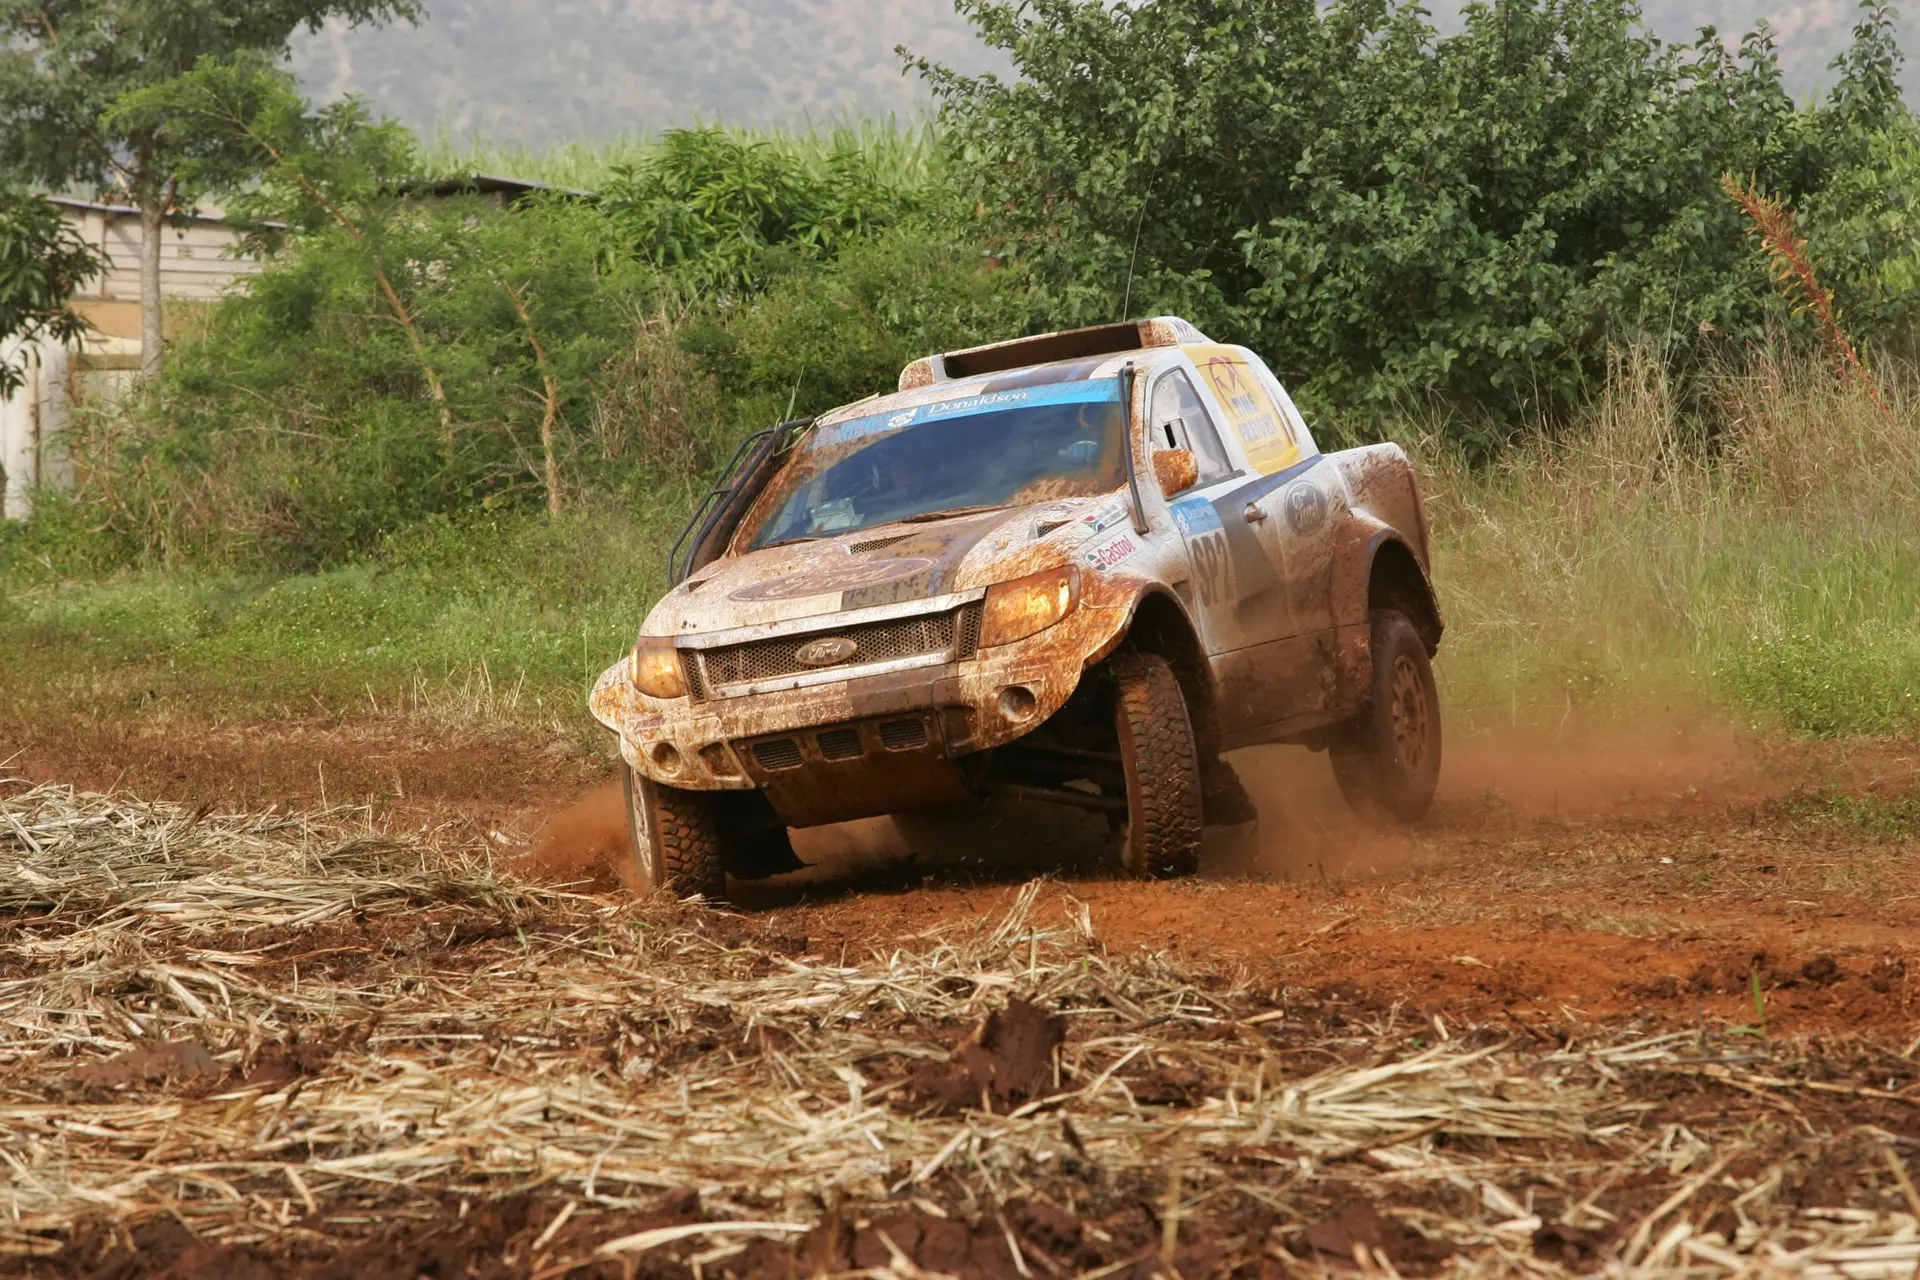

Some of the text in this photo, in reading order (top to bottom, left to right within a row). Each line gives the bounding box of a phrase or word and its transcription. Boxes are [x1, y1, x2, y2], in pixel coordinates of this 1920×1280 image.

[929, 392, 1027, 413] Donaldson
[1291, 490, 1323, 528] Ford
[1097, 534, 1136, 565] Castrol
[808, 642, 842, 659] Ford
